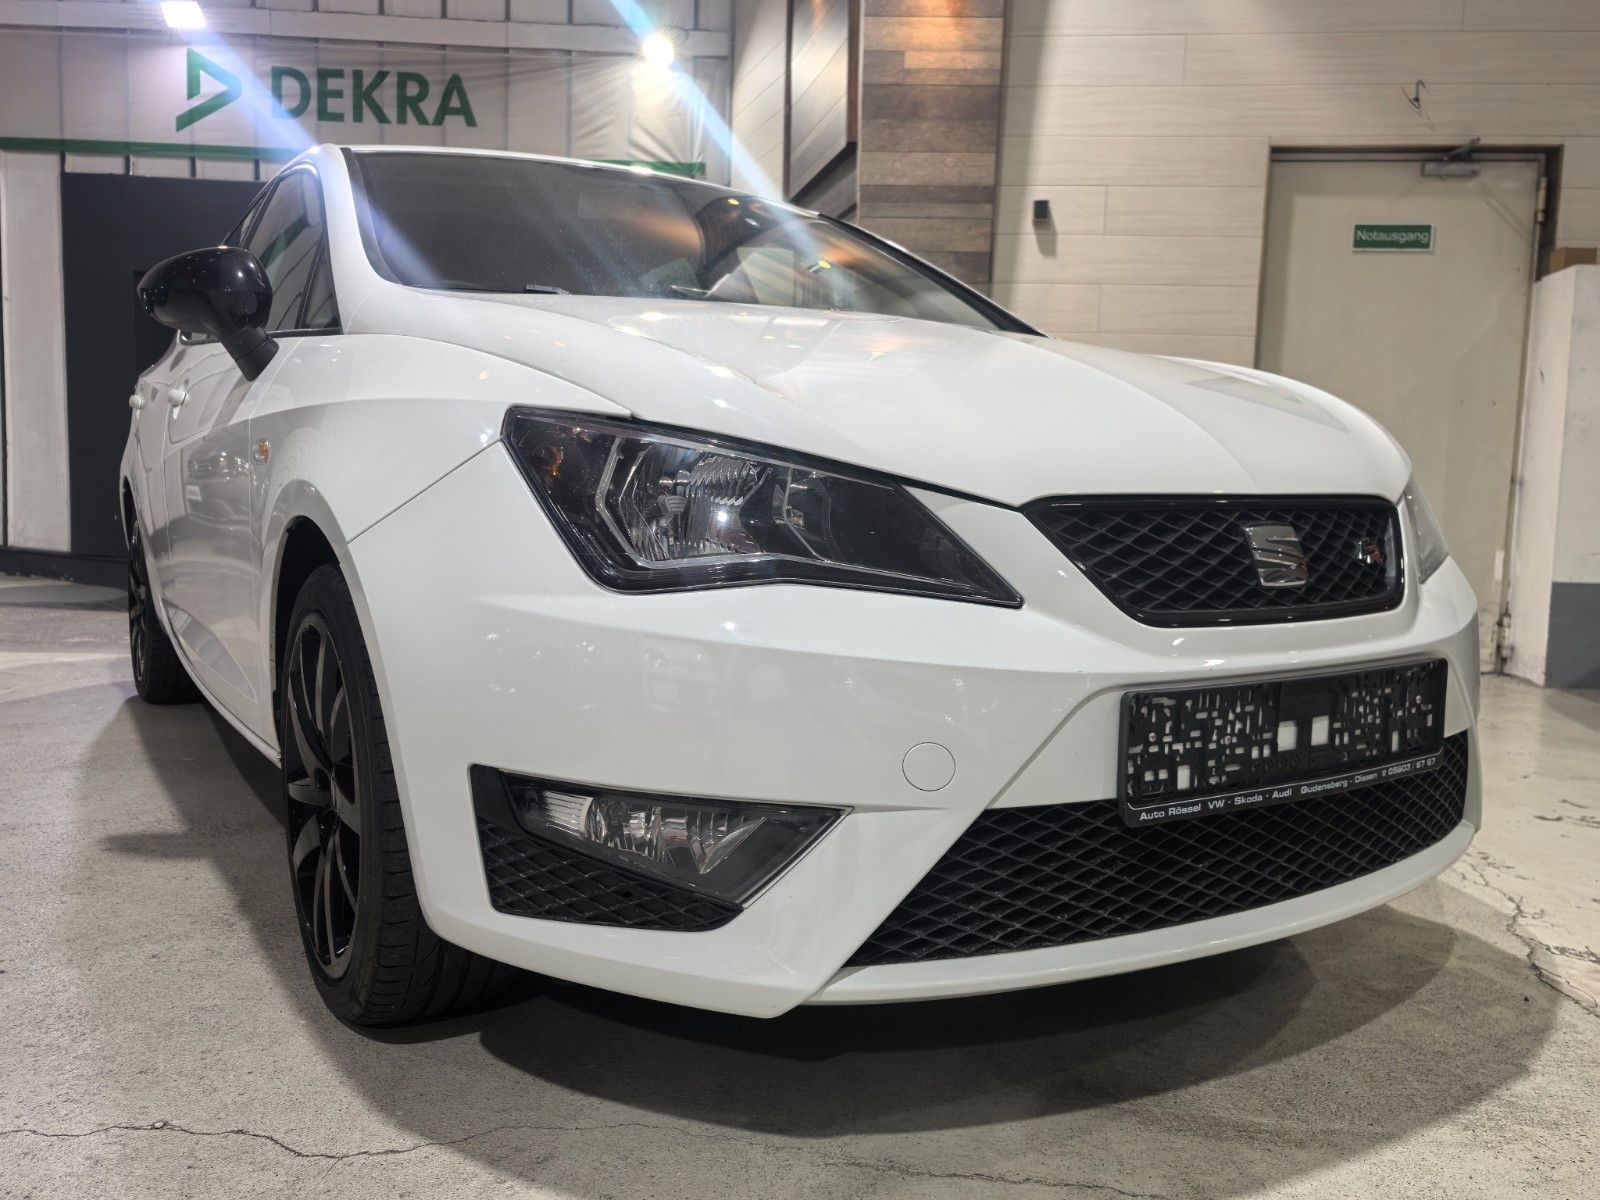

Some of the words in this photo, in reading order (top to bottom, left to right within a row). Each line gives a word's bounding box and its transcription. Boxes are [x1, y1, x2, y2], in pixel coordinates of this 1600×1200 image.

[271, 65, 478, 128] DEKRA
[1356, 229, 1429, 244] Notausgang
[1139, 811, 1165, 821] Auto
[1168, 803, 1201, 816] Rössel
[1208, 799, 1225, 810] VW
[1234, 794, 1263, 805] Skoda
[1272, 788, 1292, 799] Audi
[1300, 779, 1348, 794] Gudensberg
